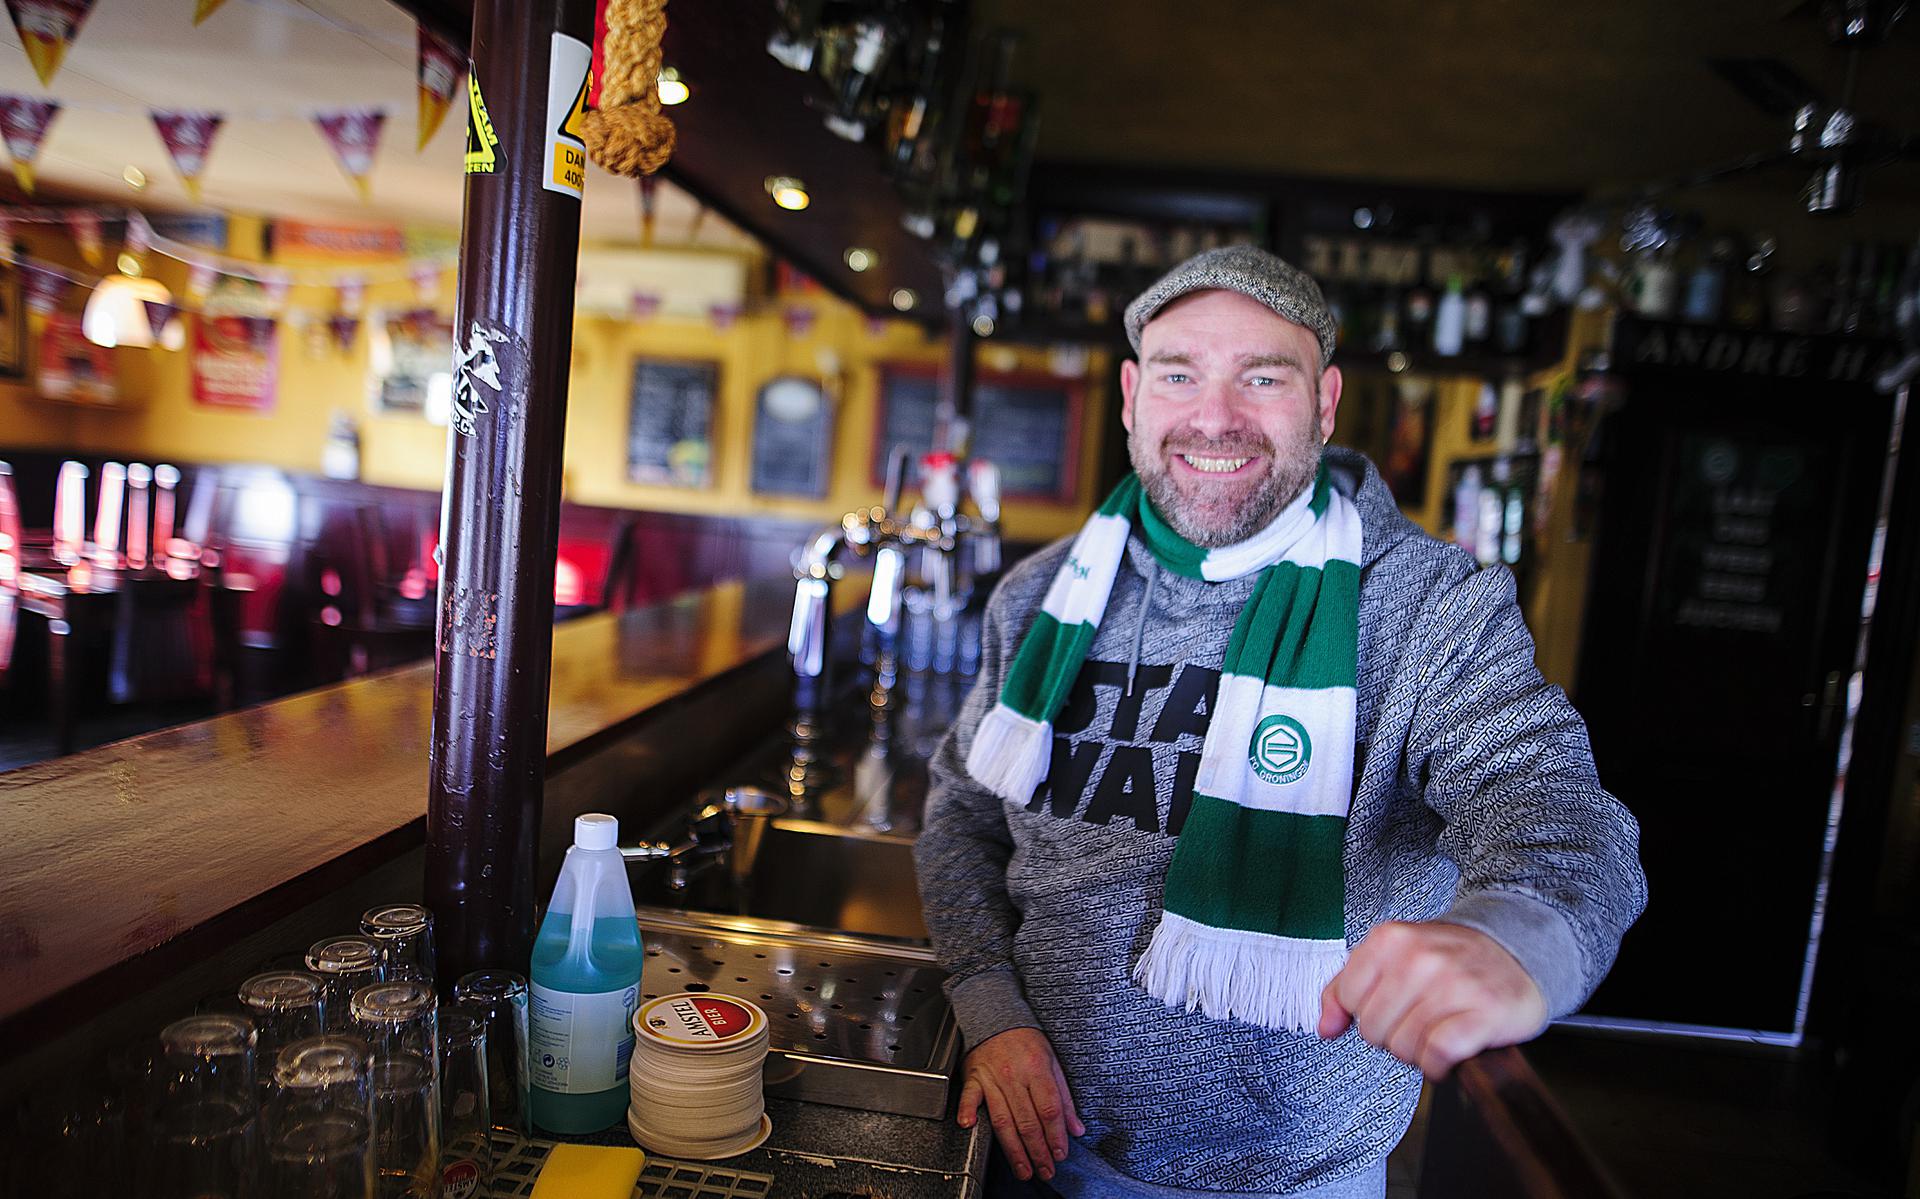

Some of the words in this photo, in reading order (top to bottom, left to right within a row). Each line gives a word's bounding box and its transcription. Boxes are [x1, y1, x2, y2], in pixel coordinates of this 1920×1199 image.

[564, 169, 586, 188] 400
[671, 1001, 712, 1037] AMSTEL
[704, 1007, 728, 1026] BIER
